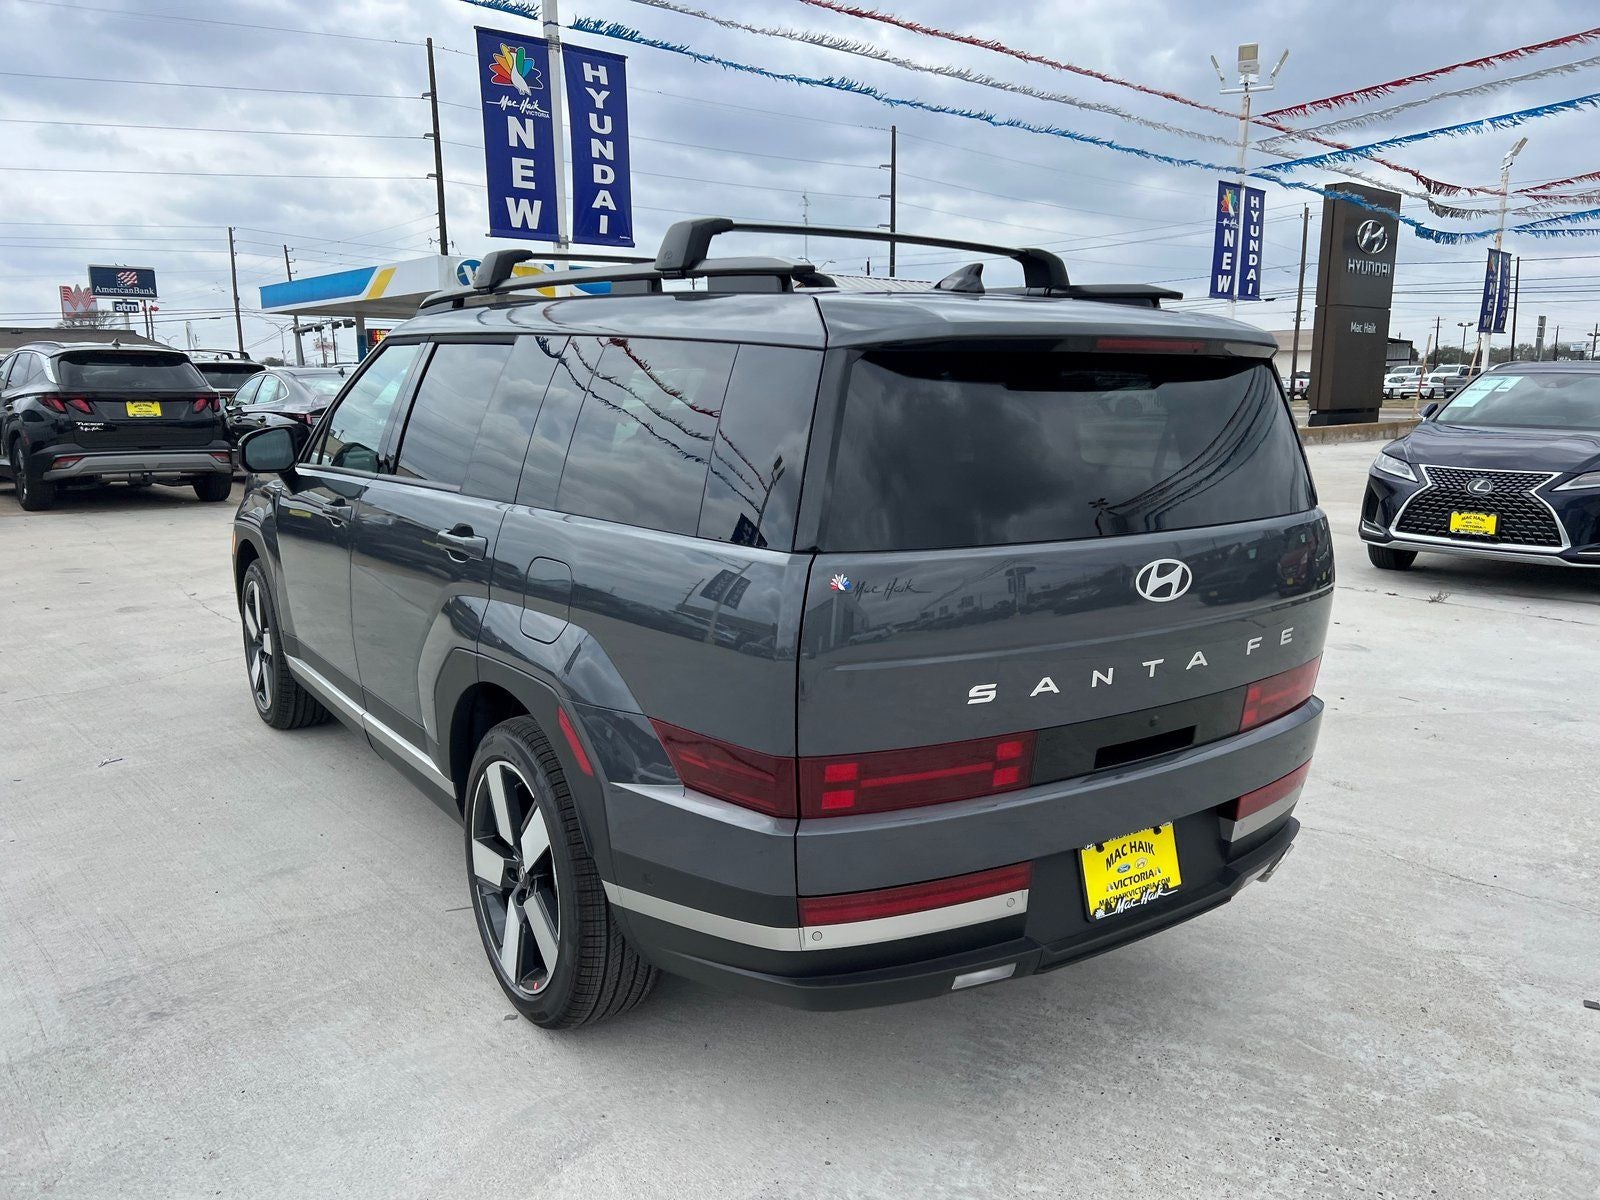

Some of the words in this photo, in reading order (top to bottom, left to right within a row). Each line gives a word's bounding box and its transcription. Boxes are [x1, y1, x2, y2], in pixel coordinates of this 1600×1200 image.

[489, 95, 519, 111] Mac
[519, 97, 549, 114] Haik
[525, 110, 550, 119] VICTORIA
[582, 62, 617, 234] HYUNDAI
[505, 115, 543, 230] NEW
[1246, 195, 1260, 295] HYUNDAI
[1217, 229, 1235, 293] NEW
[1347, 257, 1391, 278] HYUNDAI
[94, 285, 155, 296] AmericanBank
[1483, 282, 1496, 328] NEW
[1499, 258, 1510, 329] HYUNDAI
[115, 302, 138, 312] atm
[1350, 321, 1362, 333] Mac
[1363, 322, 1377, 334] Haik
[850, 580, 879, 602] Mac
[883, 577, 926, 601] Haik
[966, 650, 1209, 705] SANTA
[1245, 626, 1295, 656] FE
[1105, 843, 1128, 871] MAC
[1129, 840, 1156, 856] HAIK
[1112, 869, 1155, 890] VICTORIA
[1111, 895, 1140, 914] Mac
[1140, 884, 1173, 906] Haik
